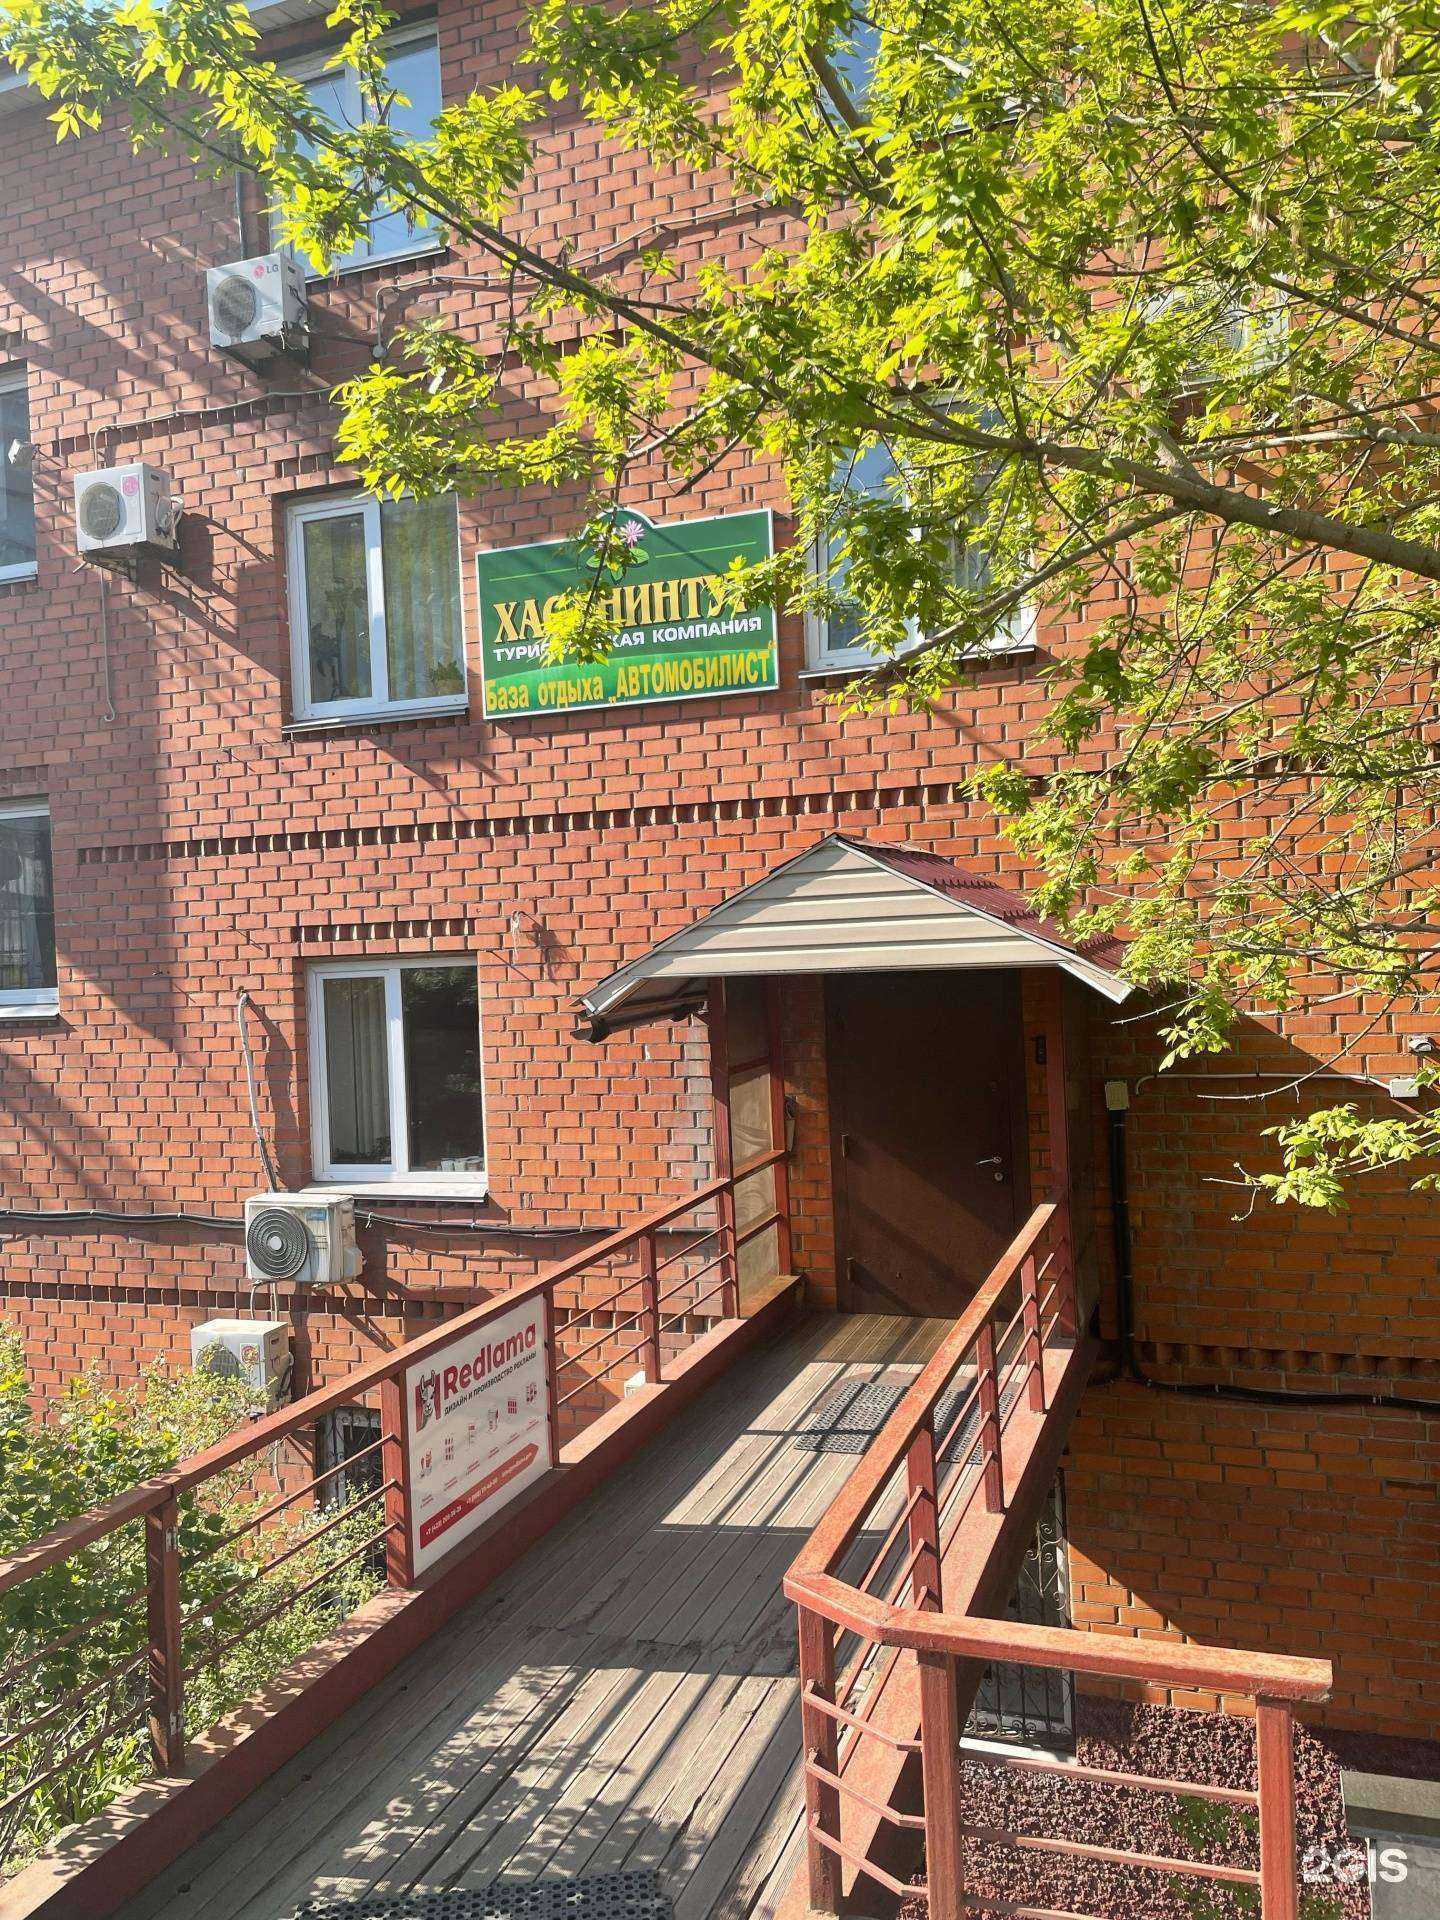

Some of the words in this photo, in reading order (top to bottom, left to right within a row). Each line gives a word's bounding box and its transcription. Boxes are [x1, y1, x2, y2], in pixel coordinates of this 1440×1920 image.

[266, 264, 279, 274] LG
[493, 572, 752, 643] ХАСНИНТУ
[652, 616, 762, 644] КОМПАНИЯ
[485, 678, 530, 712] База
[537, 675, 604, 709] отдыха
[443, 1322, 536, 1401] Redlama
[444, 1394, 468, 1416] ДИЗАЙН
[473, 1366, 513, 1397] ПРОИЗВОДСТВО
[513, 1350, 537, 1371] РЕКЛАМЫ
